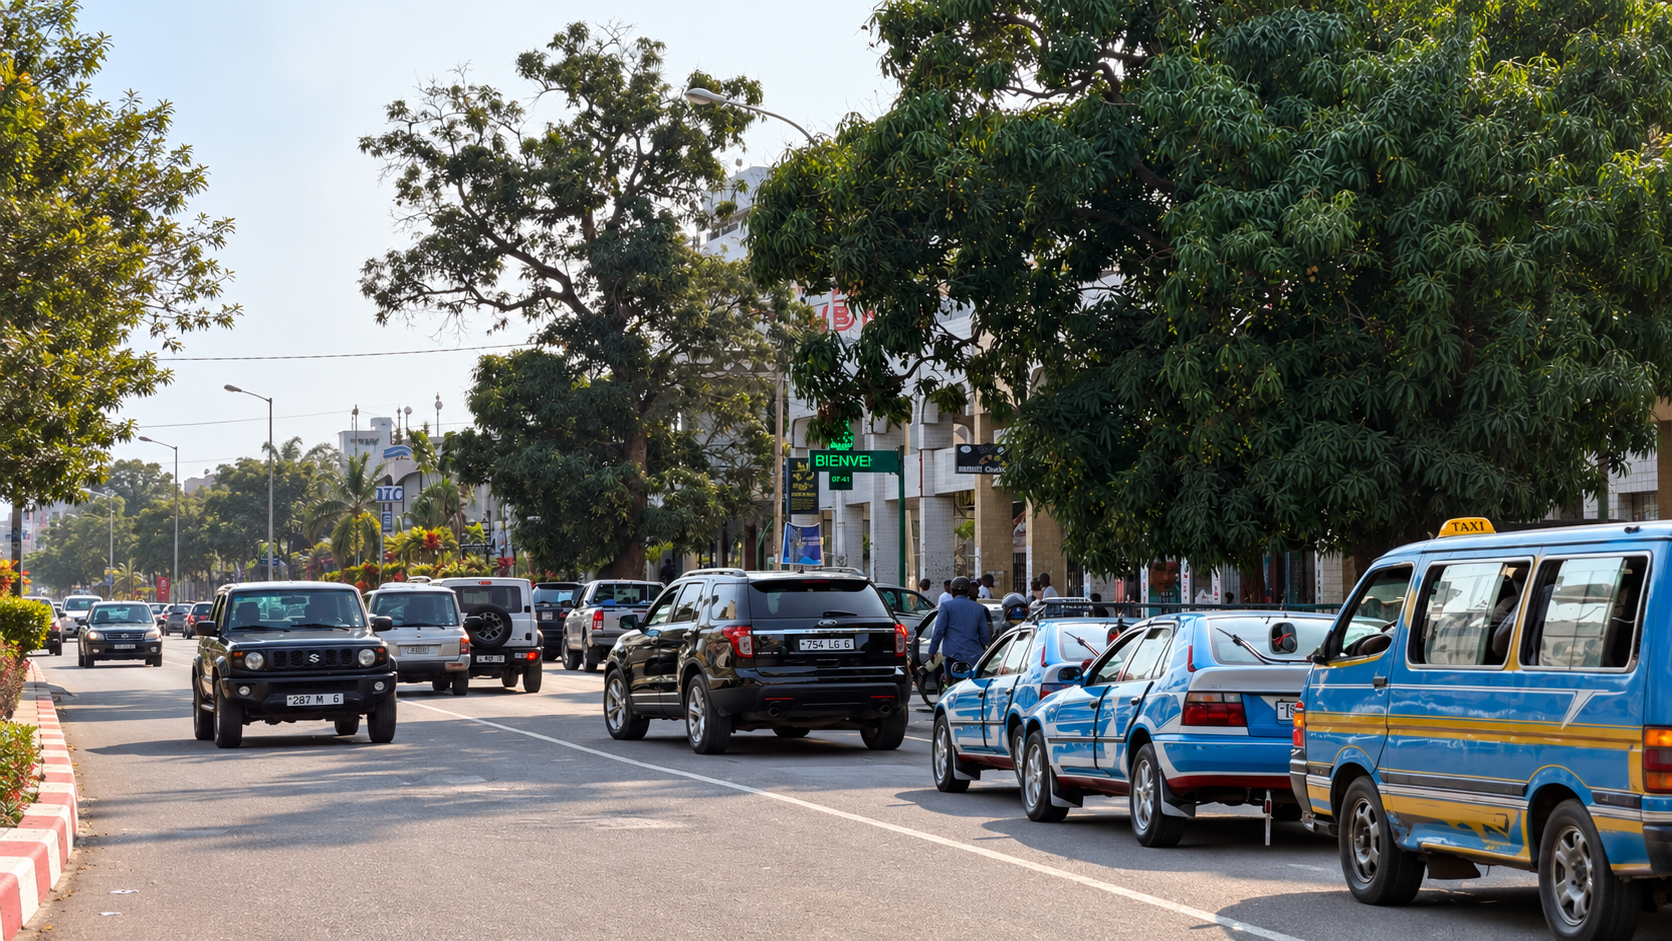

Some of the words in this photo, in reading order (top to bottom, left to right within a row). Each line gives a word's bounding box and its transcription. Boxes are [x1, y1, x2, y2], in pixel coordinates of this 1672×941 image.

[1451, 521, 1484, 532] TAXI
[807, 640, 823, 649] 754
[844, 640, 850, 648] 6
[293, 695, 311, 705] 287
[316, 695, 323, 704] M
[333, 694, 339, 703] 6
